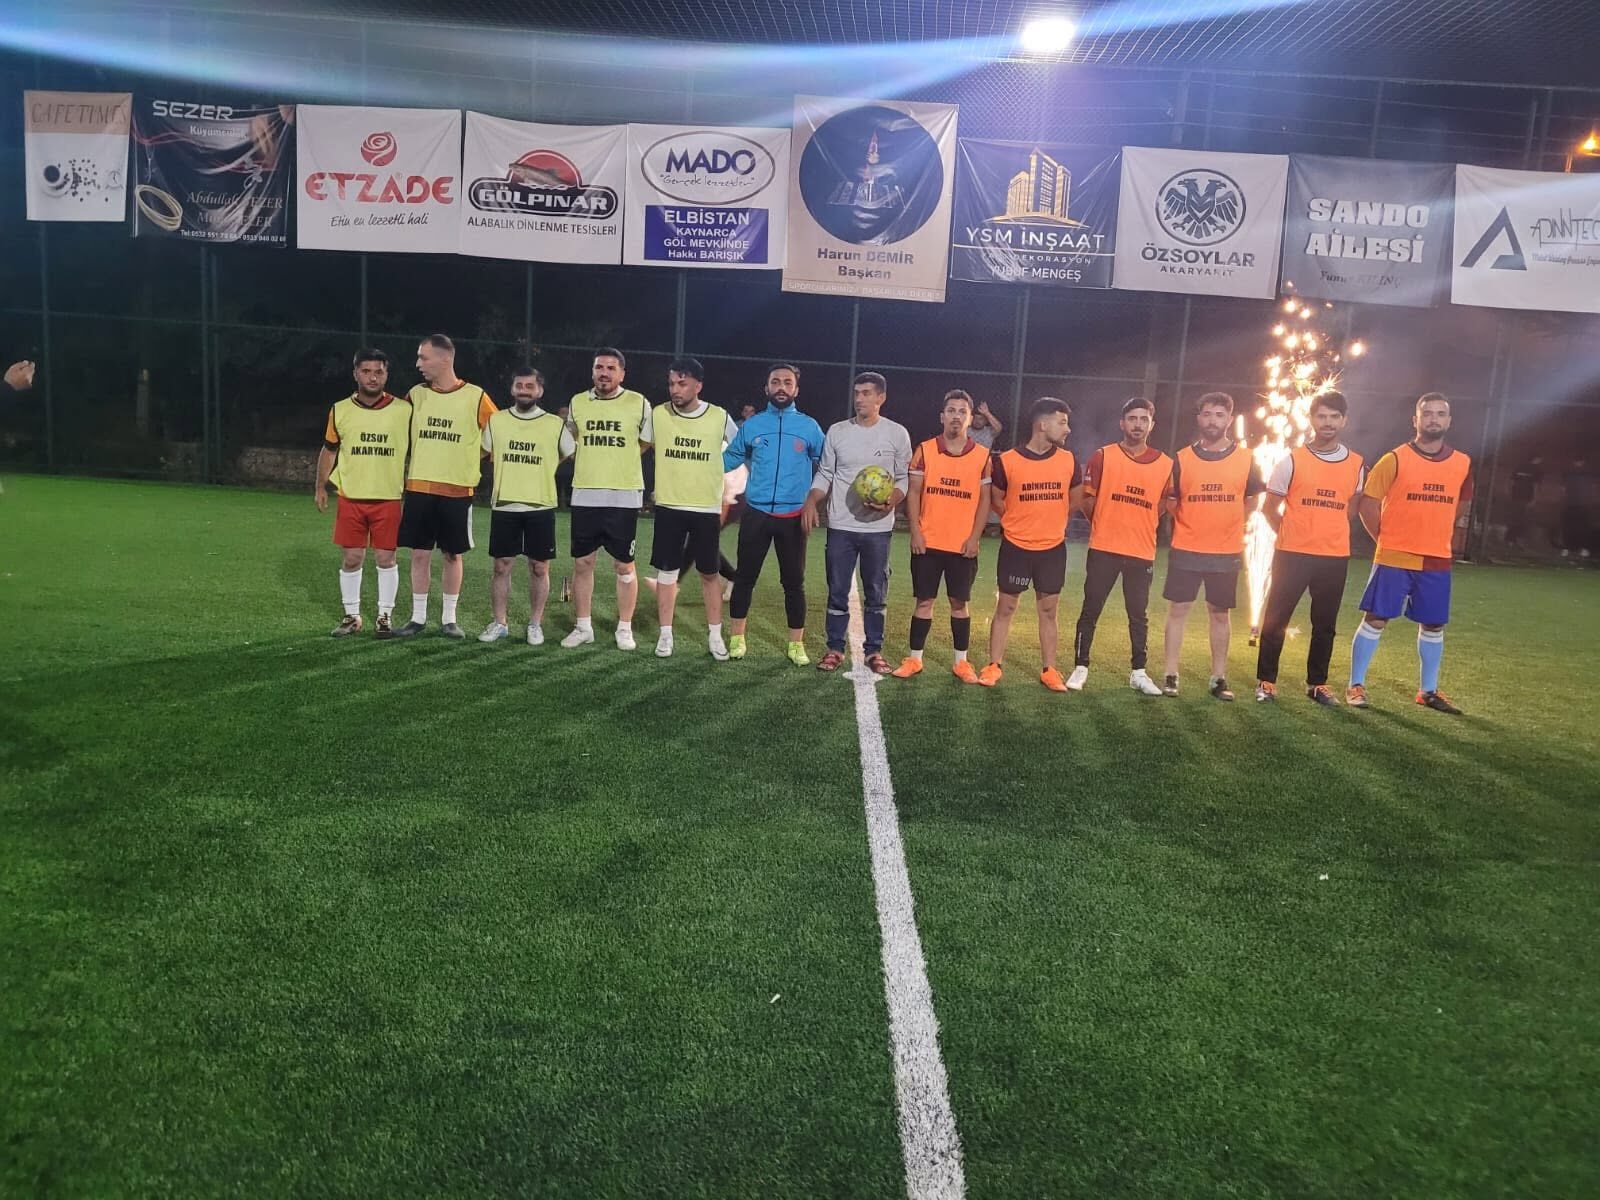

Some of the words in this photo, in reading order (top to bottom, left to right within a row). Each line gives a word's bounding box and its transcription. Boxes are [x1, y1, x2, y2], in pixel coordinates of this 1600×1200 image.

[152, 100, 233, 121] SEZER
[665, 147, 756, 175] MADO
[304, 172, 454, 204] ETZADE
[478, 186, 608, 210] GÖLPINAR
[664, 208, 750, 225] ELBİSTAN
[1308, 198, 1430, 228] SANDO
[467, 216, 514, 229] ALABALIK
[517, 219, 568, 233] DİNLENME
[571, 223, 617, 236] TESİSLERİ
[676, 227, 737, 237] KAYNARCA
[664, 237, 686, 247] GÖL
[966, 226, 1012, 244] YSM
[1021, 226, 1104, 250] İNŞAAT
[1304, 228, 1425, 263] AİLESİ
[668, 250, 697, 259] Hakkı
[700, 250, 745, 261] BARIŞIK
[817, 248, 861, 261] Harun
[866, 251, 914, 264] DEMİR
[1141, 242, 1255, 267] ÖZSOYLAR
[838, 265, 891, 280] Başkan
[1032, 267, 1081, 282] MENGEŞ
[1160, 265, 1233, 276] AKARYAKIT
[427, 416, 453, 429] ÖZSOY
[586, 420, 621, 432] CAFE
[360, 432, 388, 443] ÖZSOY
[582, 434, 625, 448] TİMES
[674, 436, 702, 448] ÖZSOY
[509, 440, 536, 452] ÖZSOY
[665, 448, 711, 461] AKARYAKIT
[940, 477, 961, 487] SEZER
[1201, 483, 1223, 492] SEZER
[1423, 483, 1445, 492] SEZER
[1125, 485, 1146, 496] SEZER
[1316, 488, 1336, 498] SEZER
